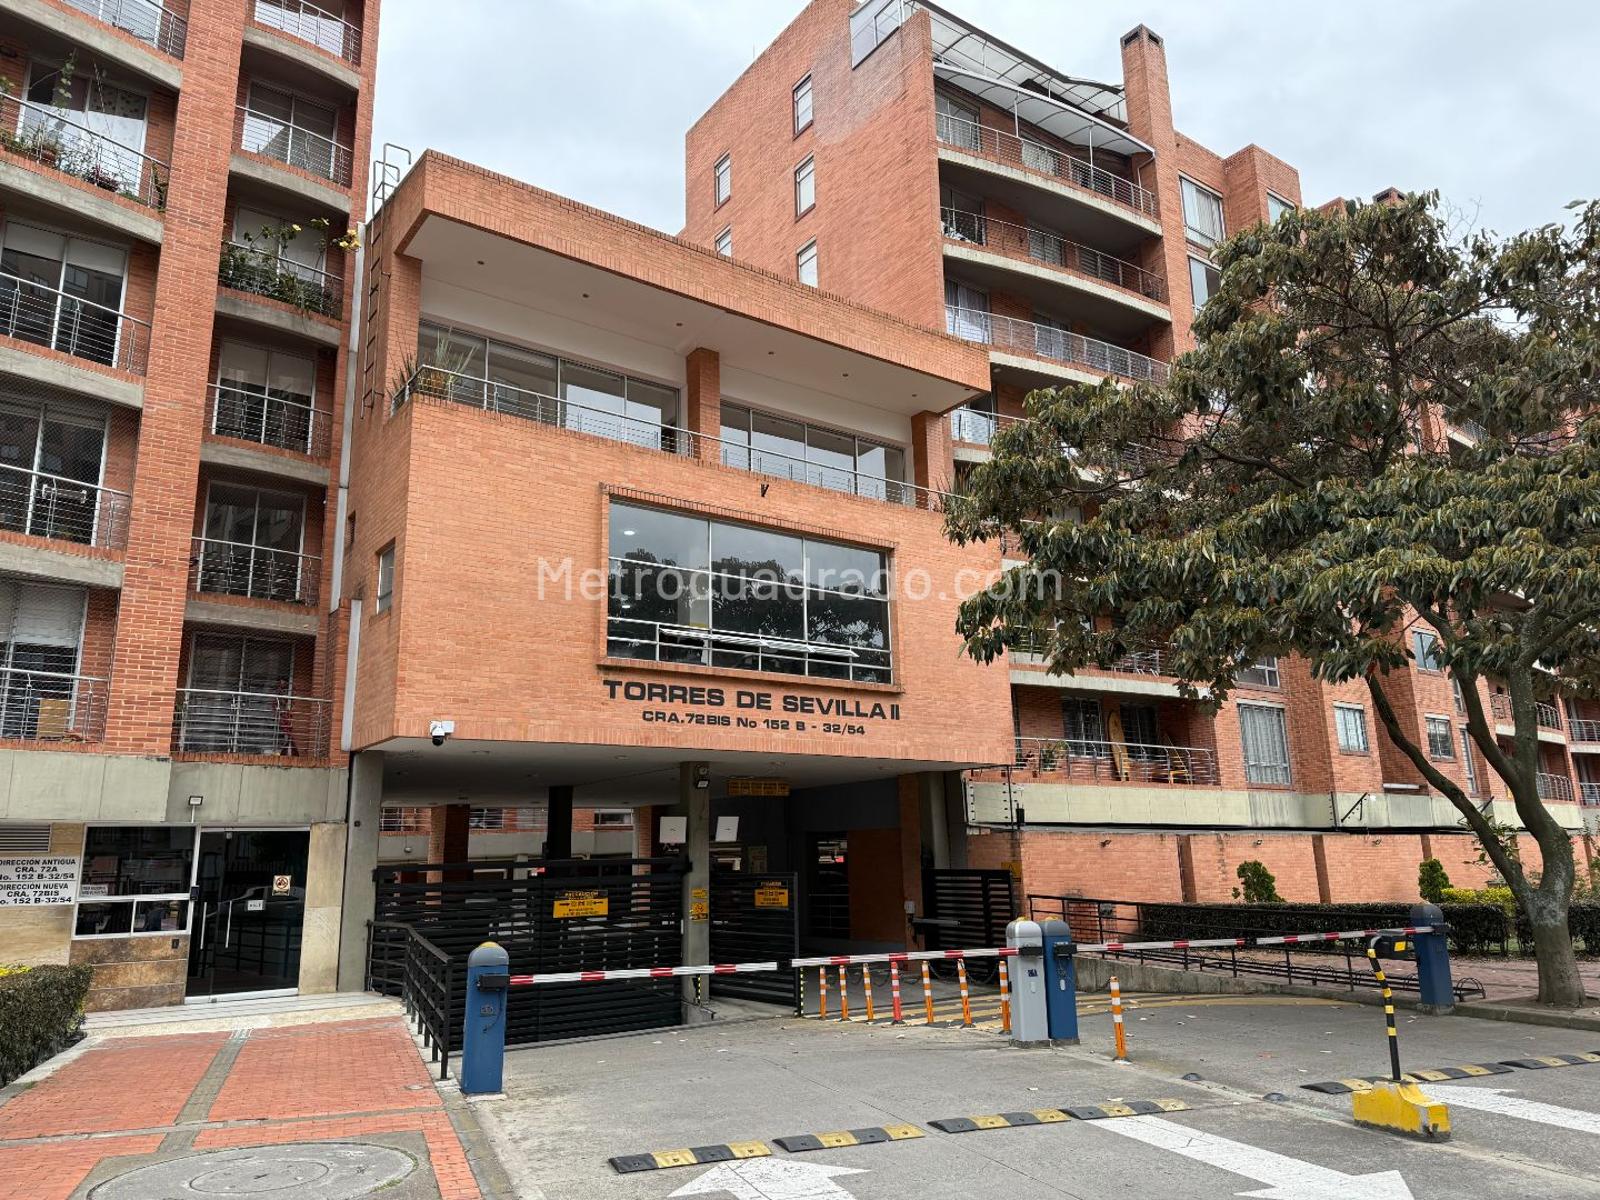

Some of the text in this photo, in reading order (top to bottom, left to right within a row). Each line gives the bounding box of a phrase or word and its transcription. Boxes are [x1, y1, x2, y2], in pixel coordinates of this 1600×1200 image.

[603, 679, 725, 706] TORRES
[736, 690, 772, 710] DE
[783, 695, 886, 720] SEVILLA
[737, 717, 757, 728] No
[762, 718, 789, 730] 152
[796, 721, 805, 731] B
[823, 722, 865, 735] 32/54
